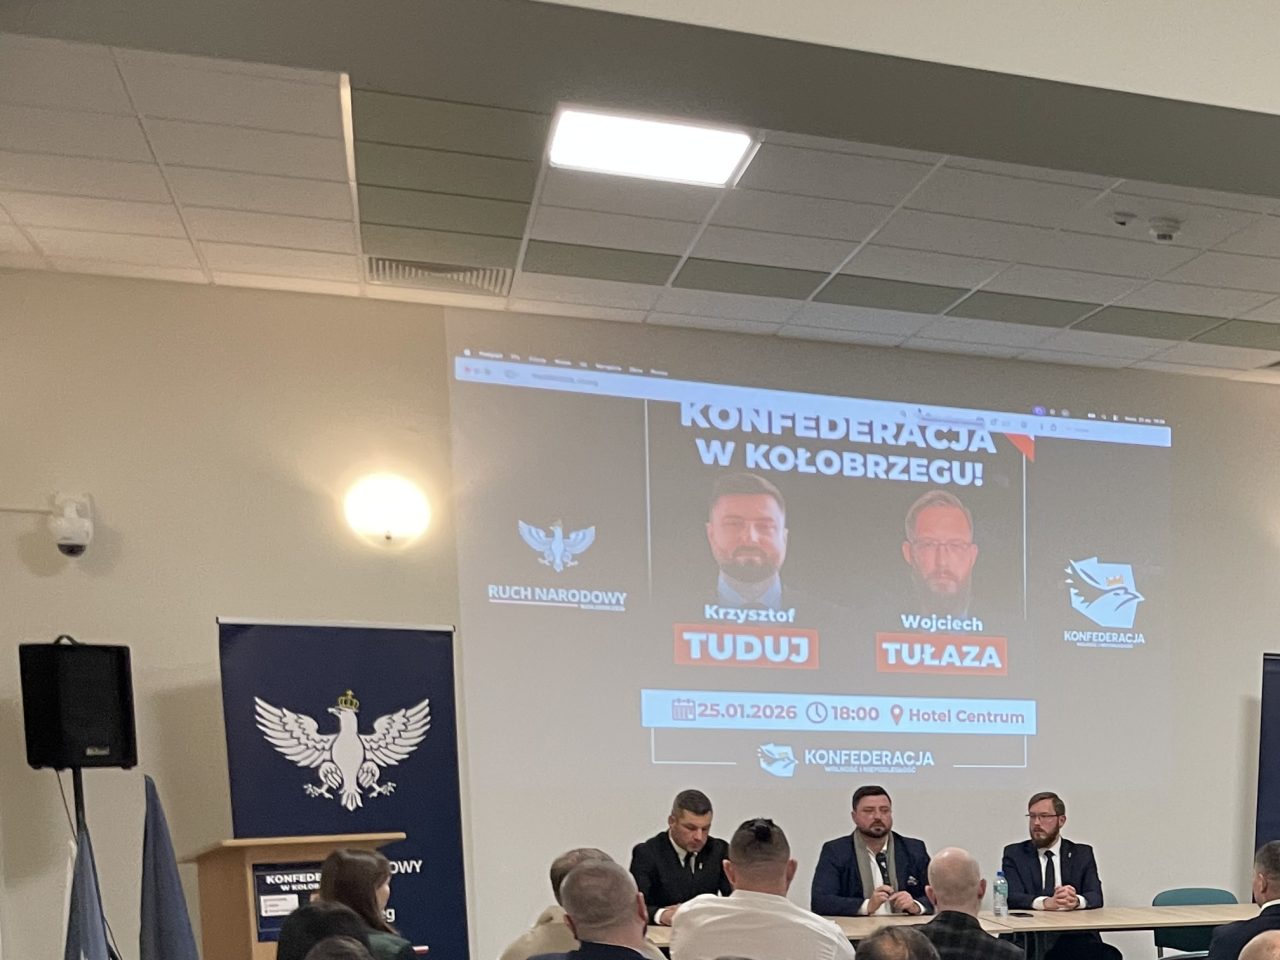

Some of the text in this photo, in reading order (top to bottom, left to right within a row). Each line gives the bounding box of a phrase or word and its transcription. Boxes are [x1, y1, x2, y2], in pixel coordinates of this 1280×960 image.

[680, 399, 998, 454] KONFEDERACJA
[696, 438, 984, 487] W KOŁOBRZEGU!
[487, 584, 627, 605] RUCH NARODOWY
[704, 603, 796, 624] Krzysztof
[901, 613, 984, 632] Wojciech
[1063, 630, 1146, 644] KONFEDERACJA
[683, 632, 811, 664] TUDUJ
[882, 640, 1003, 669] TUŁAZA
[697, 702, 1025, 725] 25.01.2026 18:00 Hotel Centrum
[804, 749, 935, 766] KONFEDERACJA
[388, 859, 423, 874] OWY
[265, 872, 322, 885] KONFEDE
